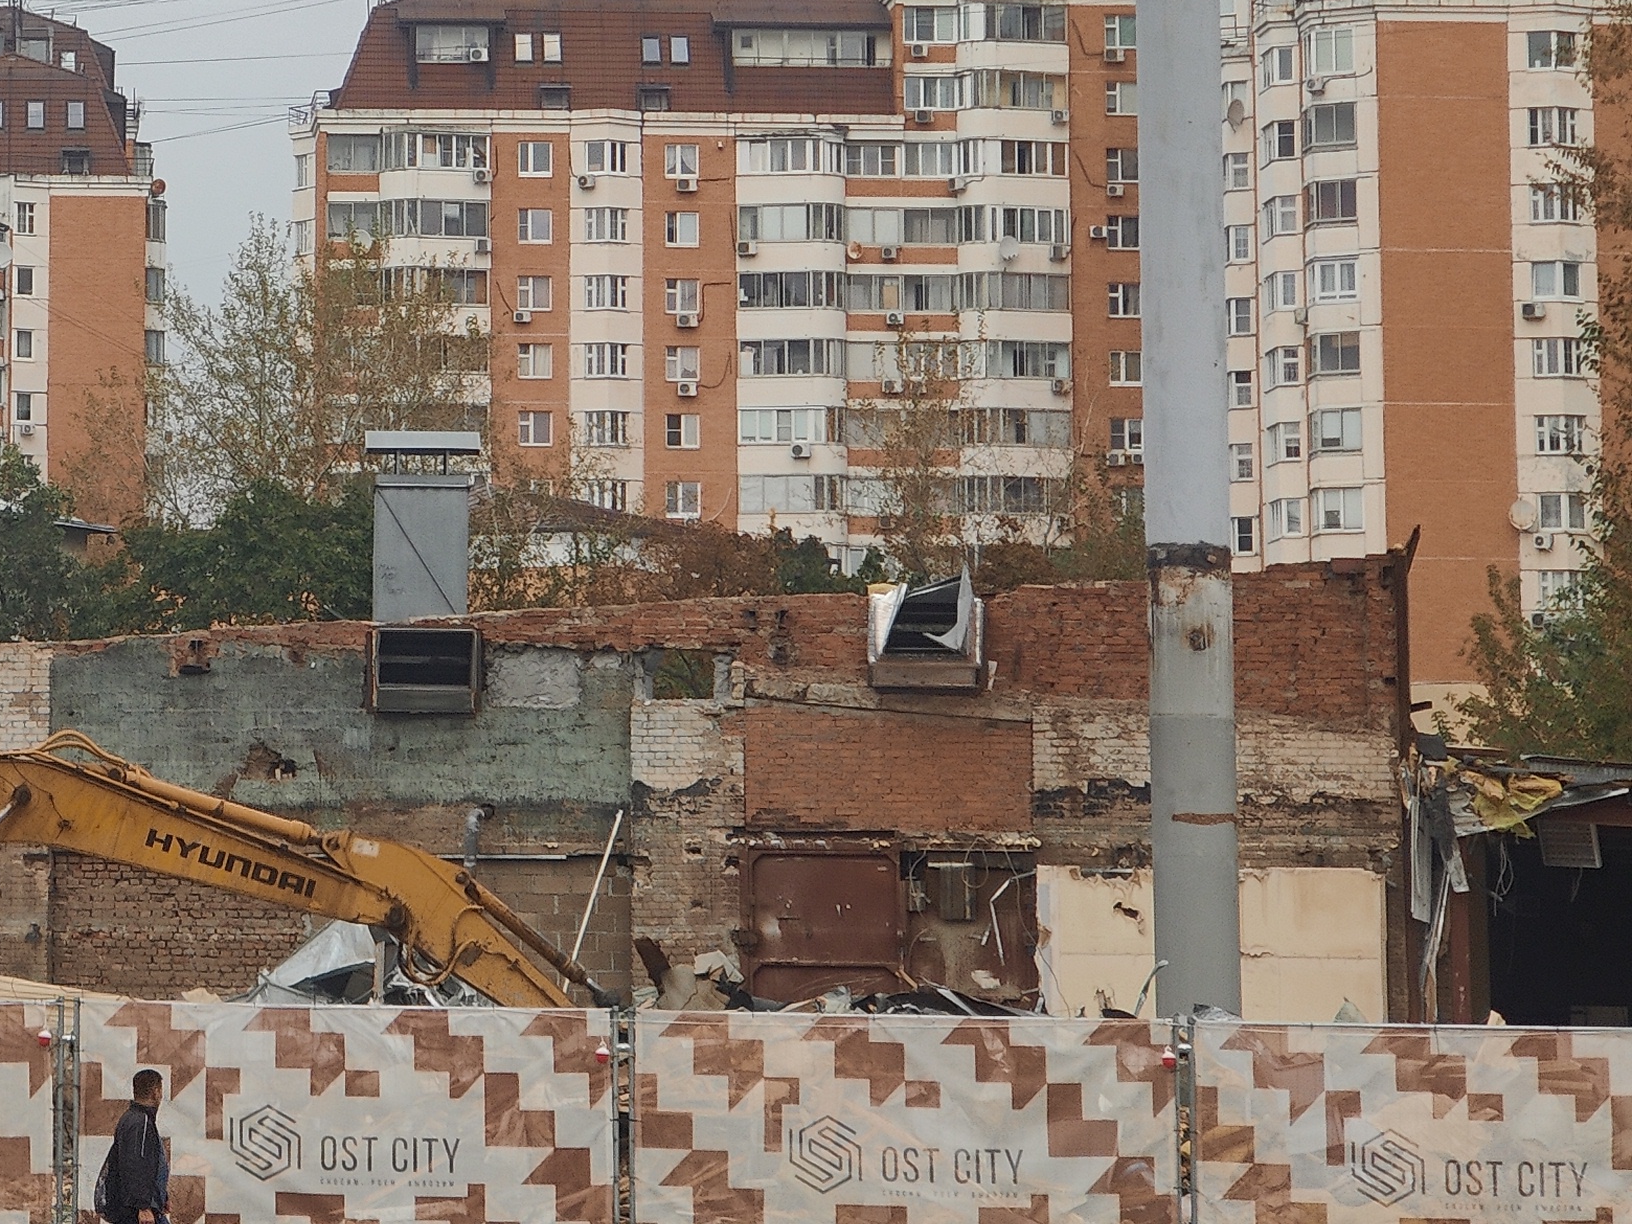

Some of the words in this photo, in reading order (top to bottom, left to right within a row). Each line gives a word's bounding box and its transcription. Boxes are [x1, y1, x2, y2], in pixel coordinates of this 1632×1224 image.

[145, 828, 317, 898] HYUNDAI
[320, 1135, 378, 1172] OST
[391, 1137, 460, 1173] CITY
[882, 1146, 940, 1183] OST
[954, 1148, 1024, 1184] CITY
[1445, 1159, 1503, 1197] OST
[1518, 1161, 1588, 1197] CITY
